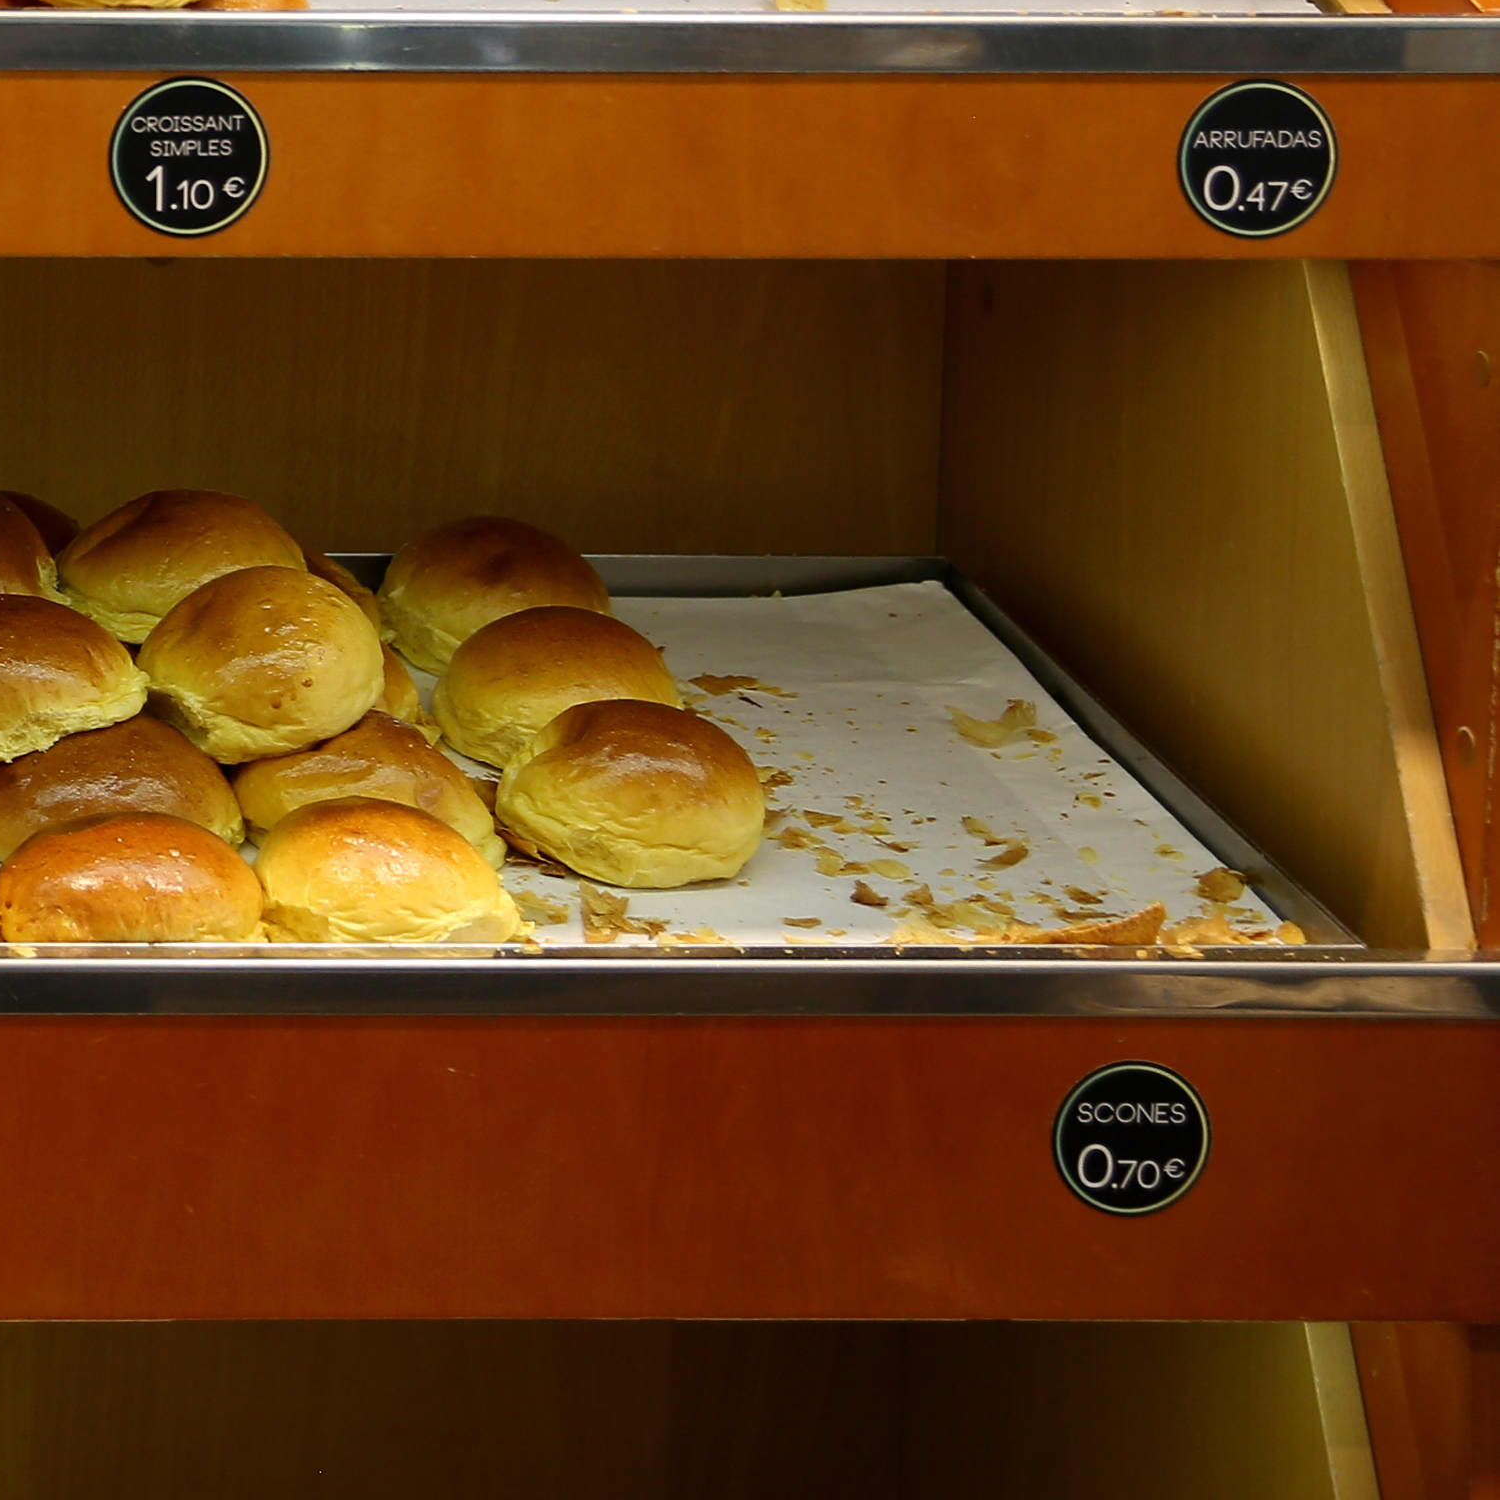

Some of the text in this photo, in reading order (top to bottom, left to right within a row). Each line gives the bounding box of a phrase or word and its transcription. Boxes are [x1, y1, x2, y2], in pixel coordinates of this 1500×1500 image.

[130, 114, 246, 134] CROISSANT
[149, 138, 232, 157] SIMPLES
[1192, 130, 1322, 150] ARRUFADAS
[1076, 1102, 1186, 1124] SCONES
